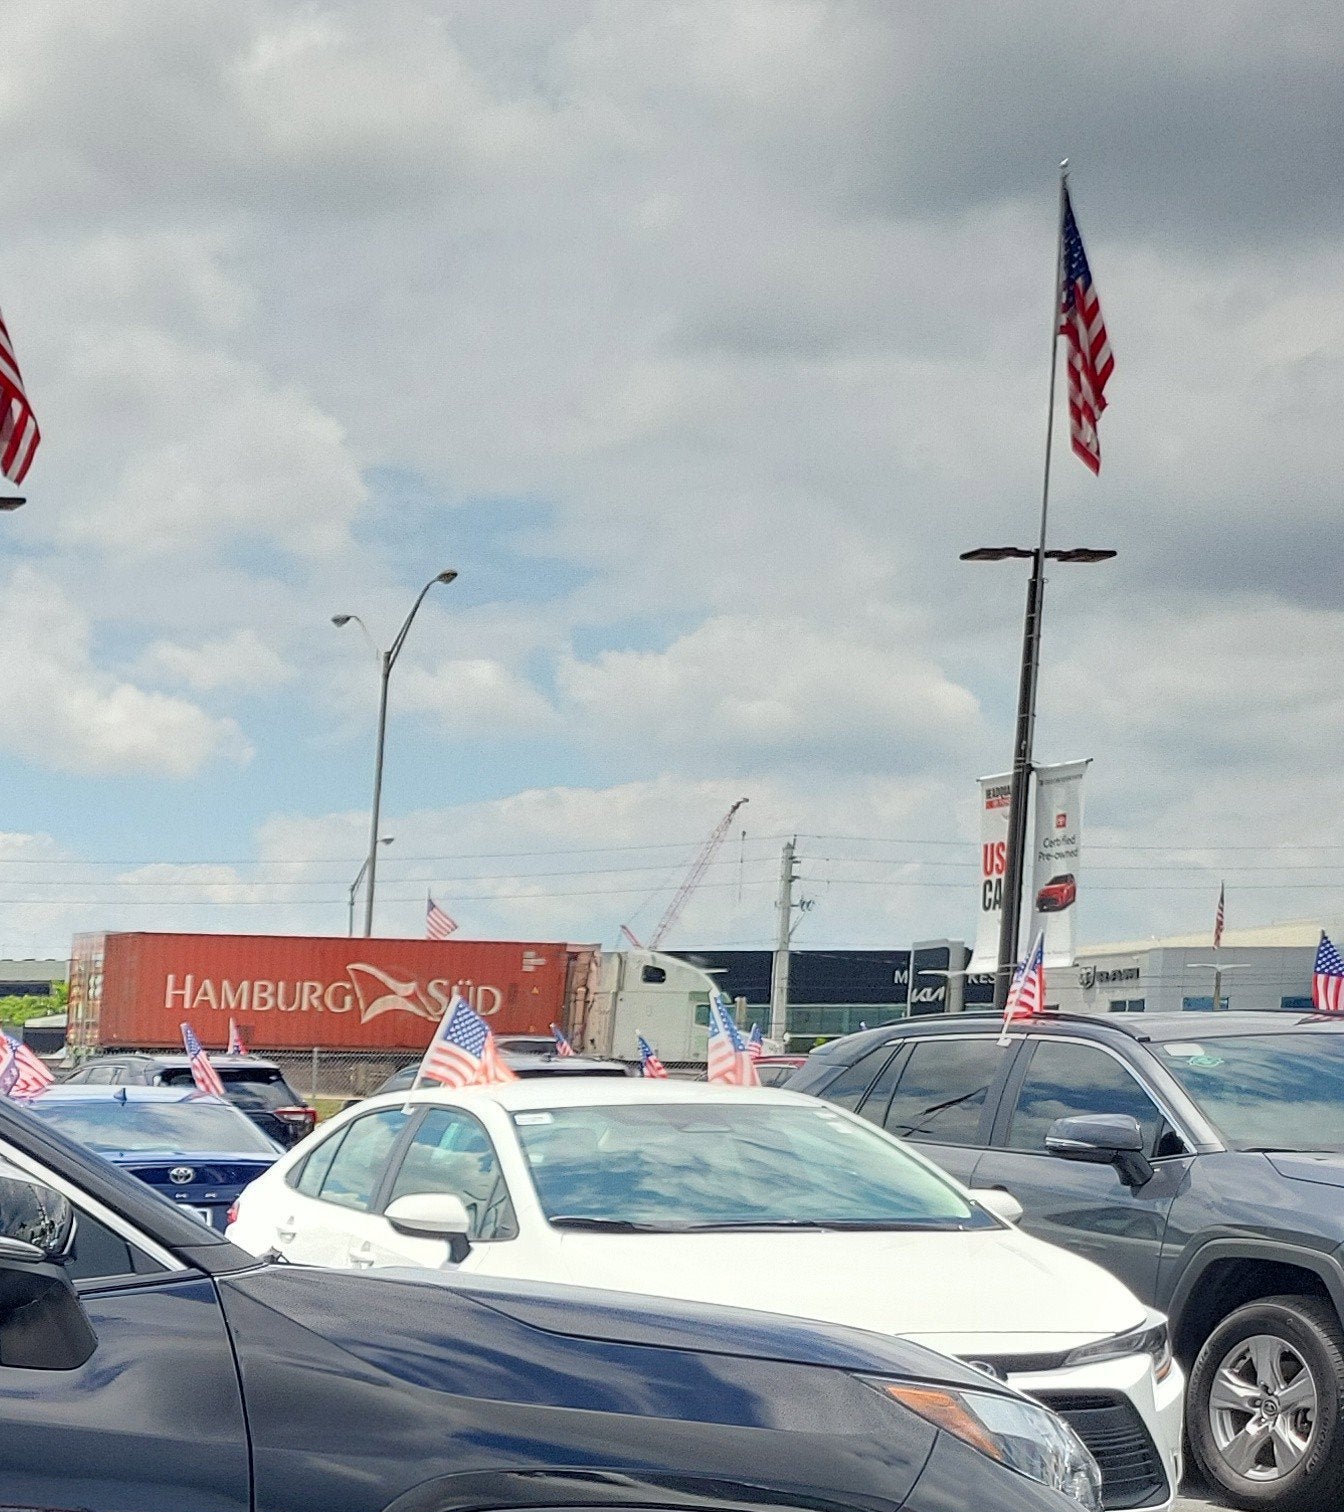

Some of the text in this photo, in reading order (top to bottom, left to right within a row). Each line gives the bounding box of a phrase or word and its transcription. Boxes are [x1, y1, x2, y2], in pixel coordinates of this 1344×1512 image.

[1042, 833, 1077, 849] Certified
[982, 841, 1007, 877] US
[1037, 848, 1079, 862] Pre-owned
[163, 973, 503, 1017] HAMBURG SÜD
